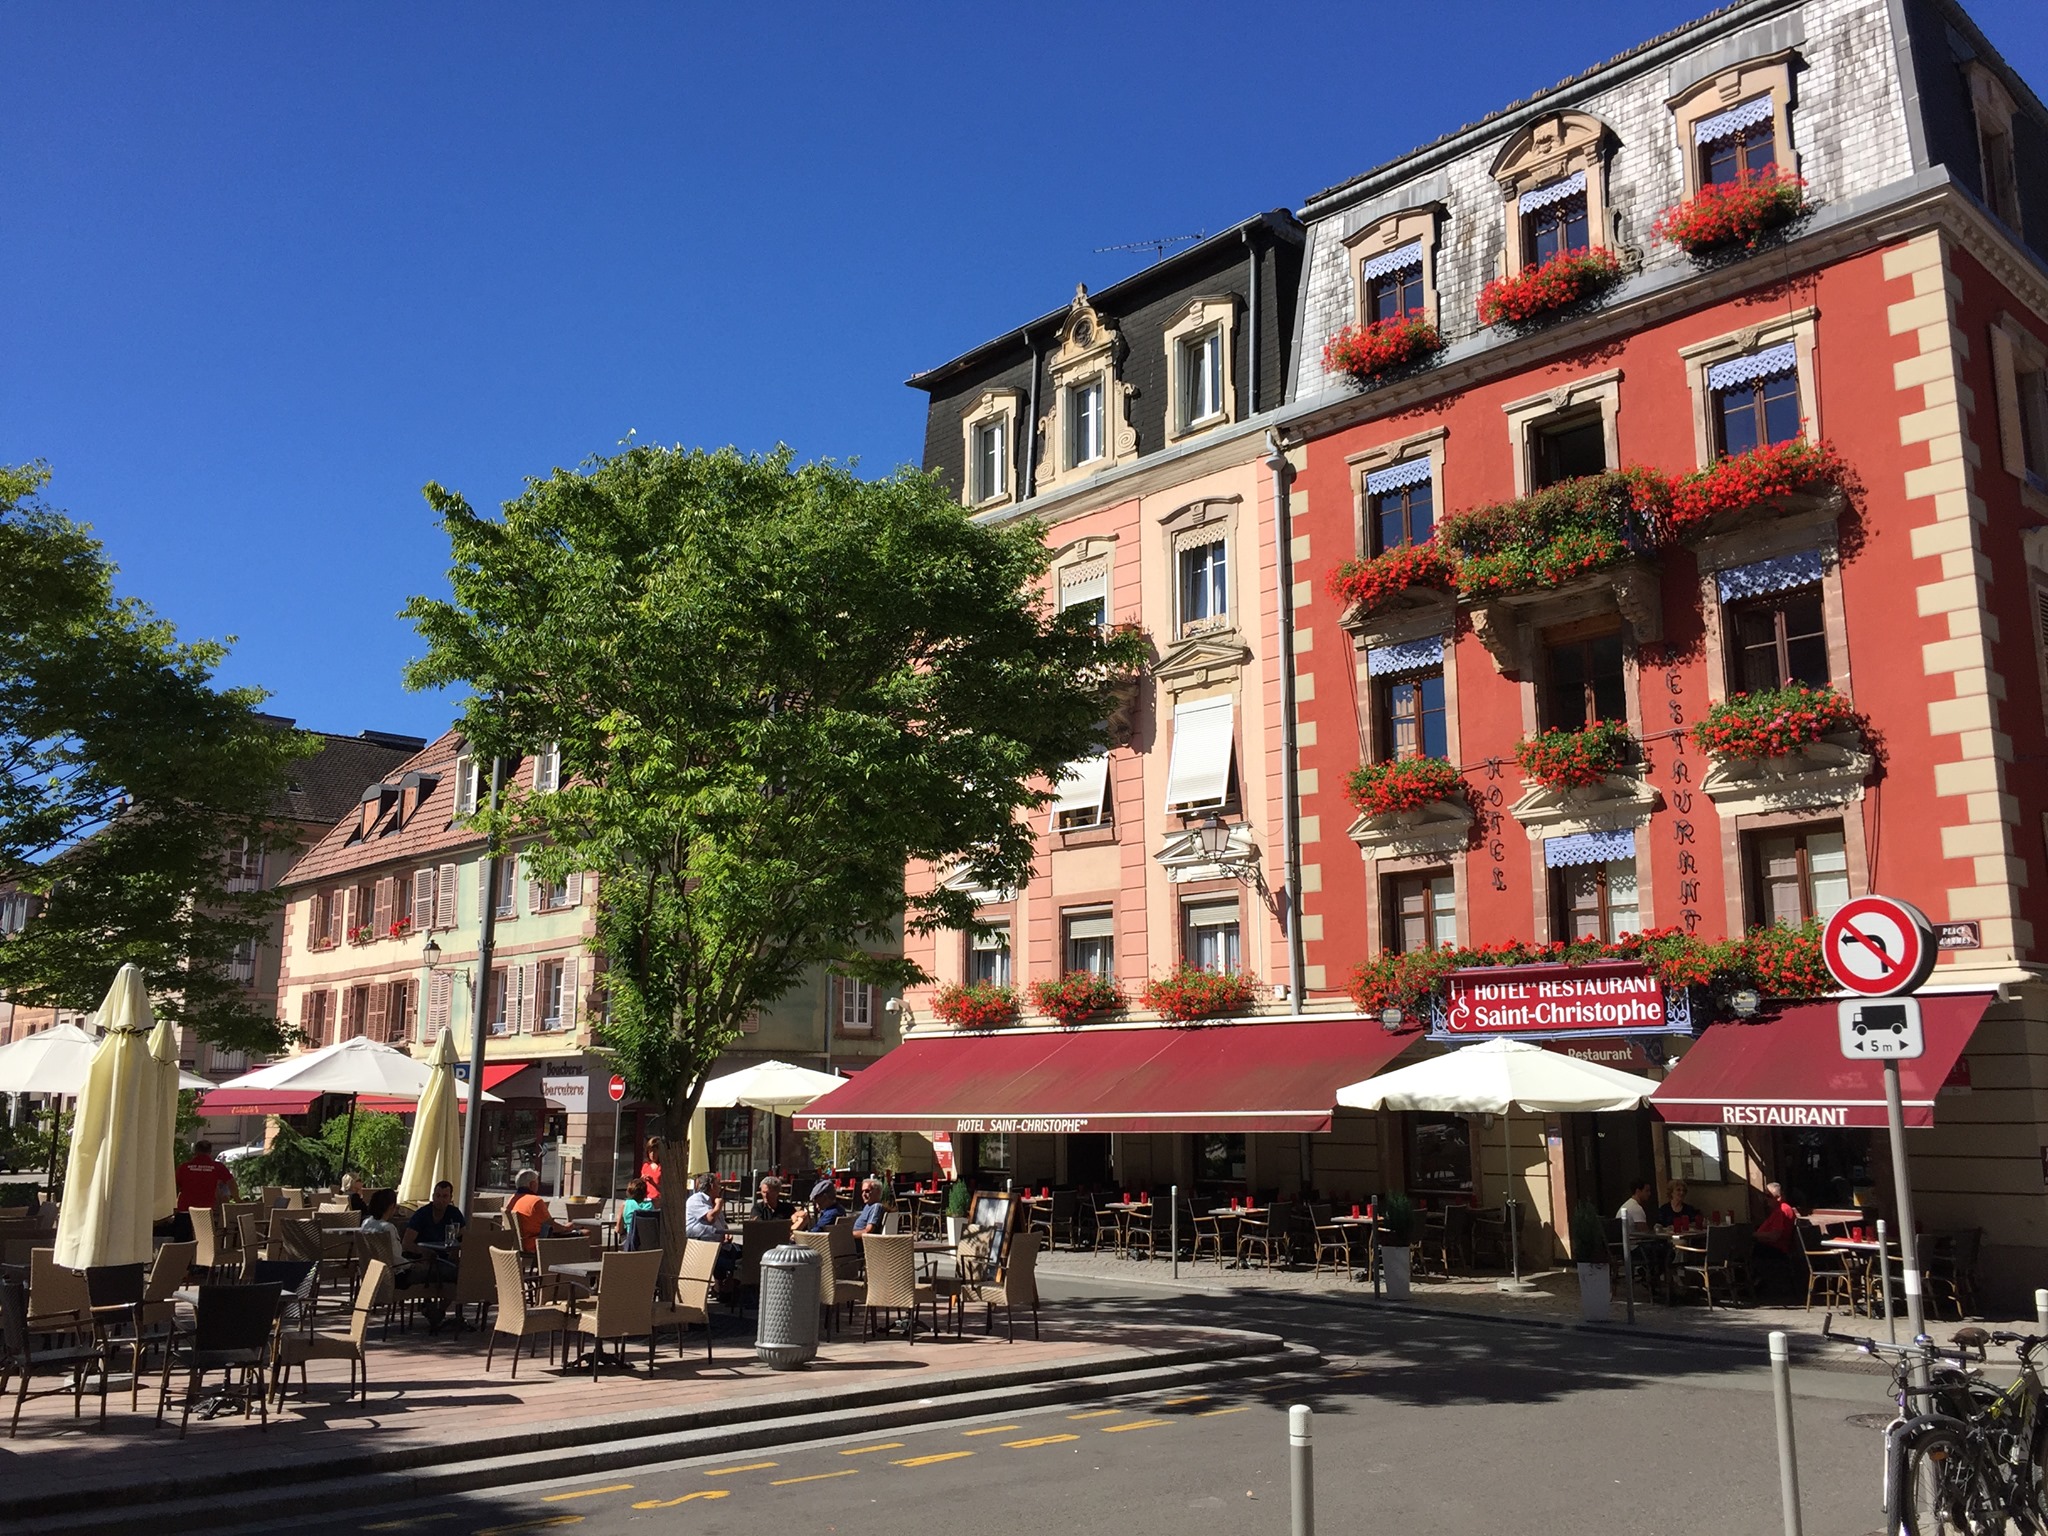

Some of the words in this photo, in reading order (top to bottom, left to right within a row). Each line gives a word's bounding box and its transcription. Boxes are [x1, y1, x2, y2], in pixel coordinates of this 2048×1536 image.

[1475, 982, 1530, 1001] HOTEL
[1538, 975, 1657, 998] RESTAURANT
[1475, 999, 1662, 1027] Saint-Christophe
[1871, 1039, 1880, 1052] 5
[1882, 1044, 1893, 1052] m
[1568, 1047, 1633, 1061] Restaurant
[1722, 1106, 1848, 1125] RESTAURANT
[807, 1118, 827, 1130] CAFE
[957, 1119, 985, 1132] HOTEL
[990, 1118, 1081, 1132] SAINT-CHRISTOPHE
